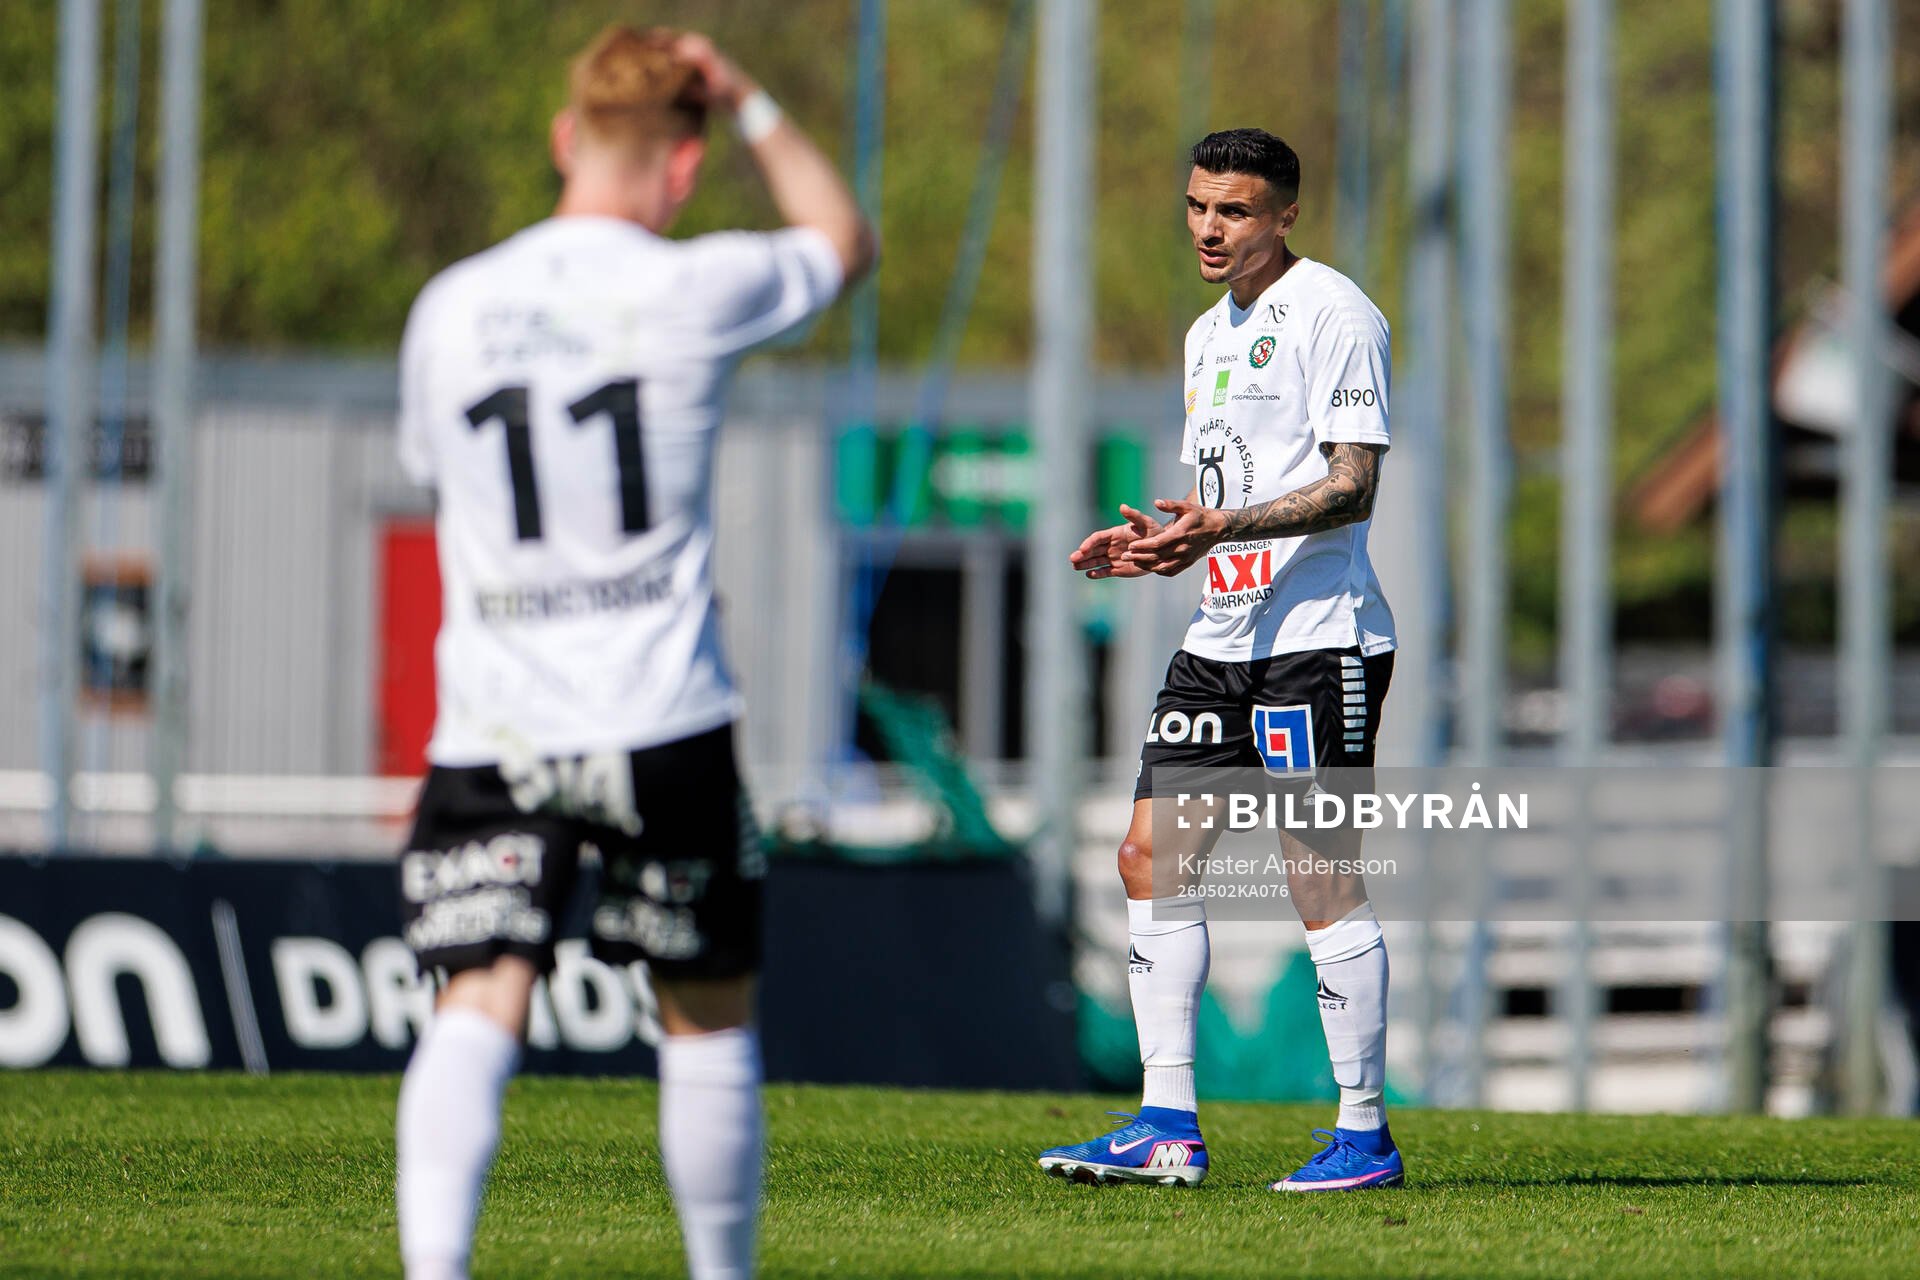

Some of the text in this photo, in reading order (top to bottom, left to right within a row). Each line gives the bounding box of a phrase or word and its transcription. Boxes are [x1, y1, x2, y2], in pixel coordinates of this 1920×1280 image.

[1331, 389, 1375, 407] 8190
[464, 376, 650, 541] 11
[1232, 436, 1254, 494] PASSION
